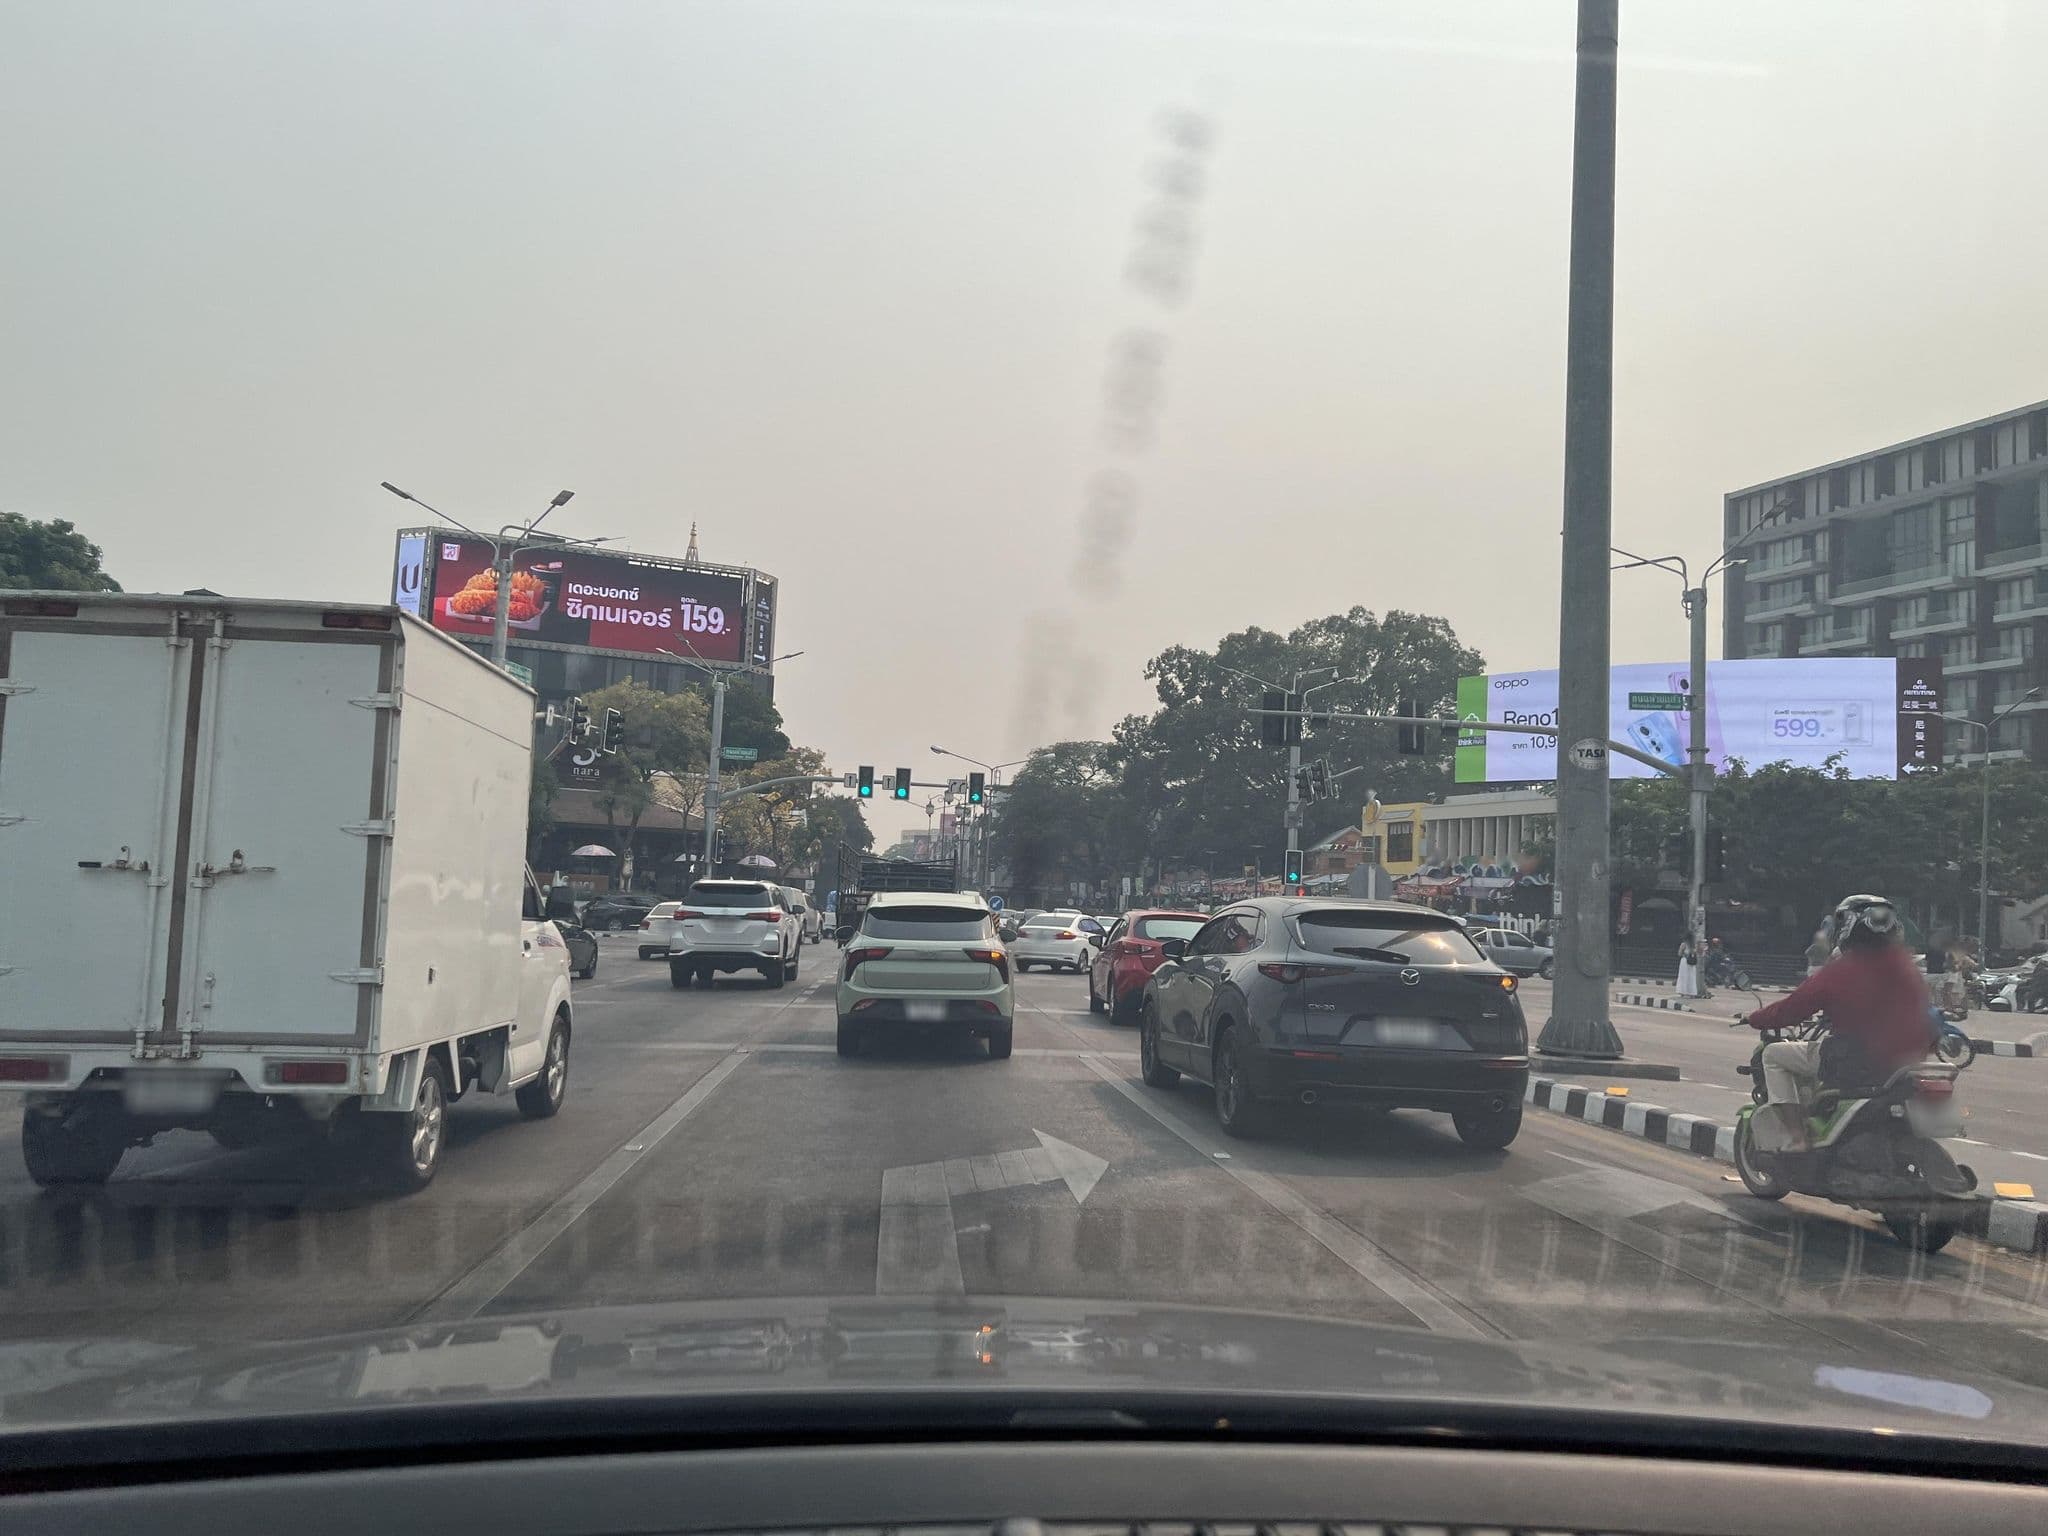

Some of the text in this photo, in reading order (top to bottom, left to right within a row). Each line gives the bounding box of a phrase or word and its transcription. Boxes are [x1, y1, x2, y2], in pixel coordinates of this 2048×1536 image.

[568, 582, 640, 601] เดอะบอกซ์
[566, 598, 673, 629] ซิกเนเจอร์
[1529, 735, 1557, 750] 10,9
[573, 767, 600, 777] nara
